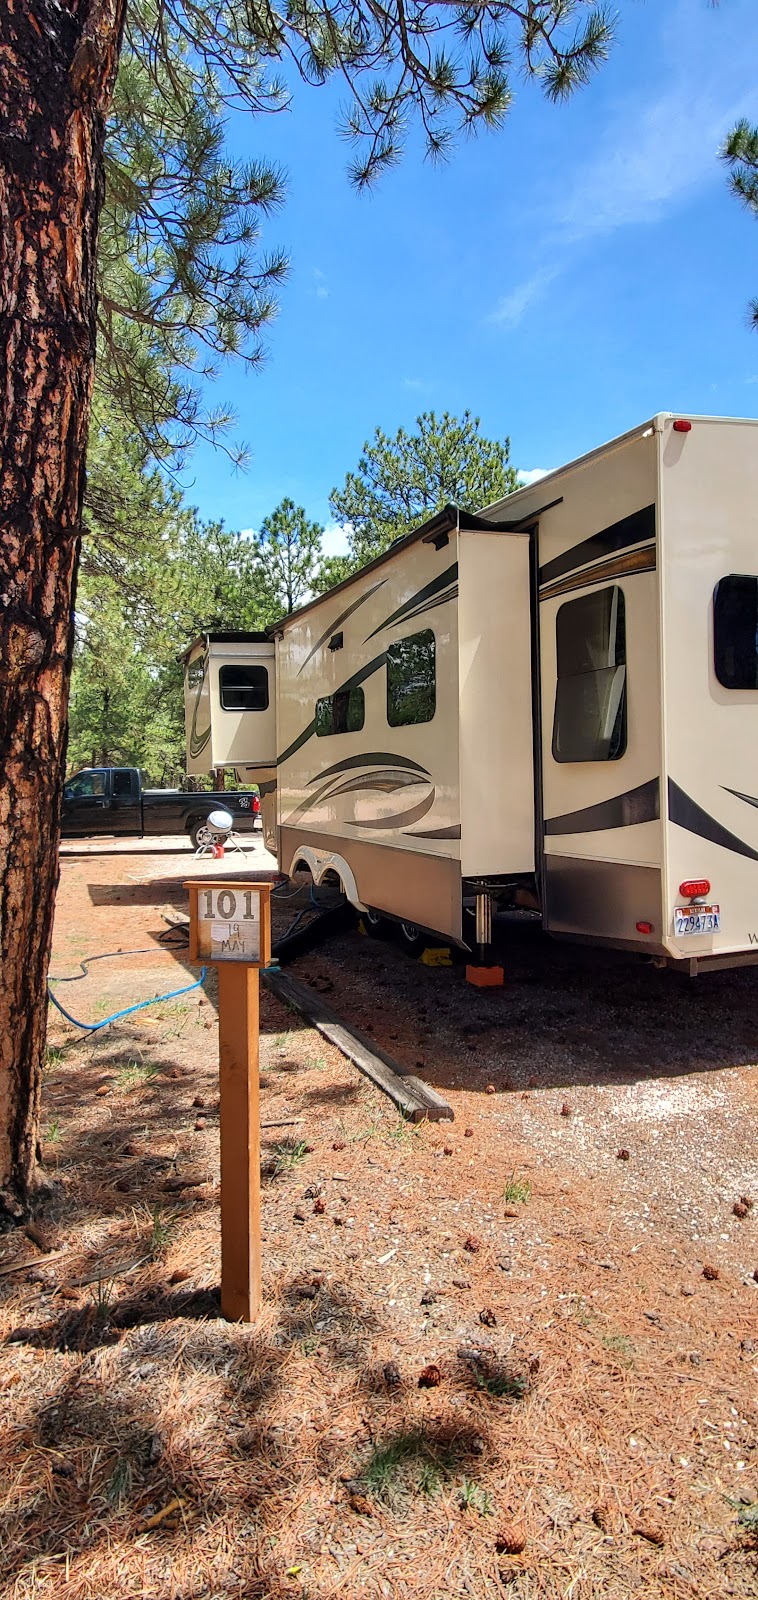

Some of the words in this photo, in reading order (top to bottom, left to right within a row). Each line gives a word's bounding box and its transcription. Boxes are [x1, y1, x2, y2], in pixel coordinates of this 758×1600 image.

[204, 890, 254, 919] 101
[228, 923, 240, 938] 19
[221, 939, 245, 953] MAY
